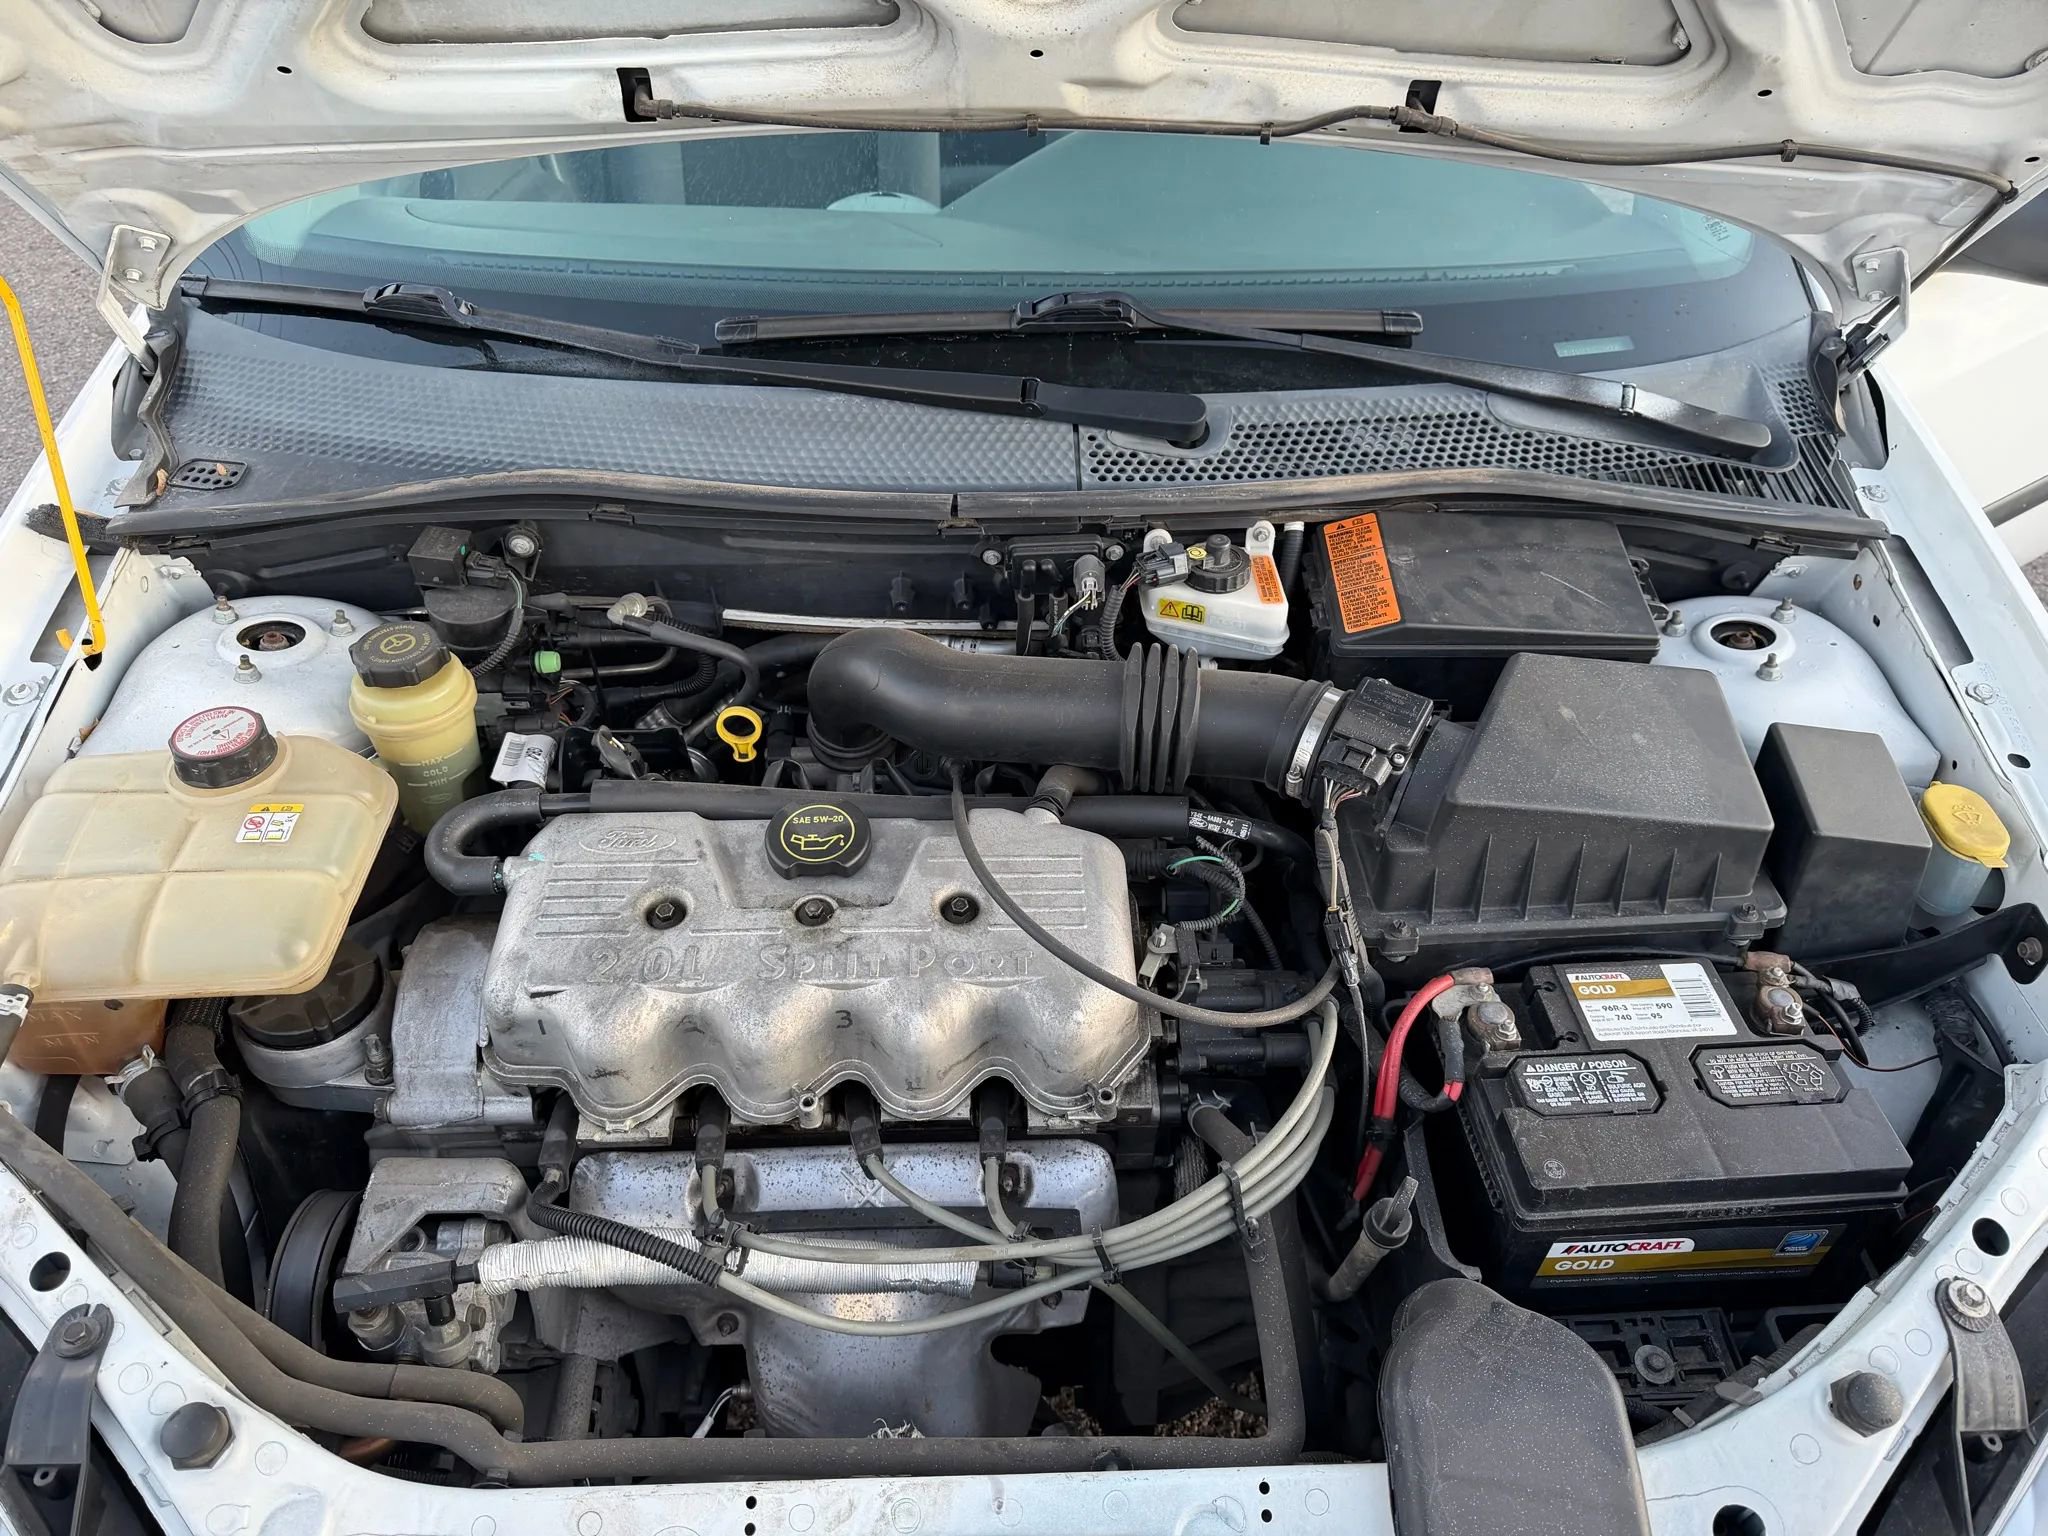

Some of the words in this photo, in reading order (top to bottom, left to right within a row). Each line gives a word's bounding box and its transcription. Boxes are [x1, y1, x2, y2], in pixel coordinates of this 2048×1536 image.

[421, 756, 443, 766] MAX
[424, 766, 448, 778] COLD
[792, 816, 812, 824] SAE
[813, 814, 844, 824] 5W-20
[600, 830, 657, 850] Ford
[586, 945, 706, 984] 2.0L
[1580, 972, 1623, 981] AUTOCRAFT
[1579, 983, 1615, 996] GOLD
[1602, 1004, 1627, 1012] 96R-3
[836, 1010, 853, 1028] 3
[1536, 1062, 1577, 1072] DANGER
[1588, 1059, 1626, 1069] POISON
[1577, 1240, 1684, 1254] AUTOCRAFT
[1554, 1259, 1615, 1271] GOLD
